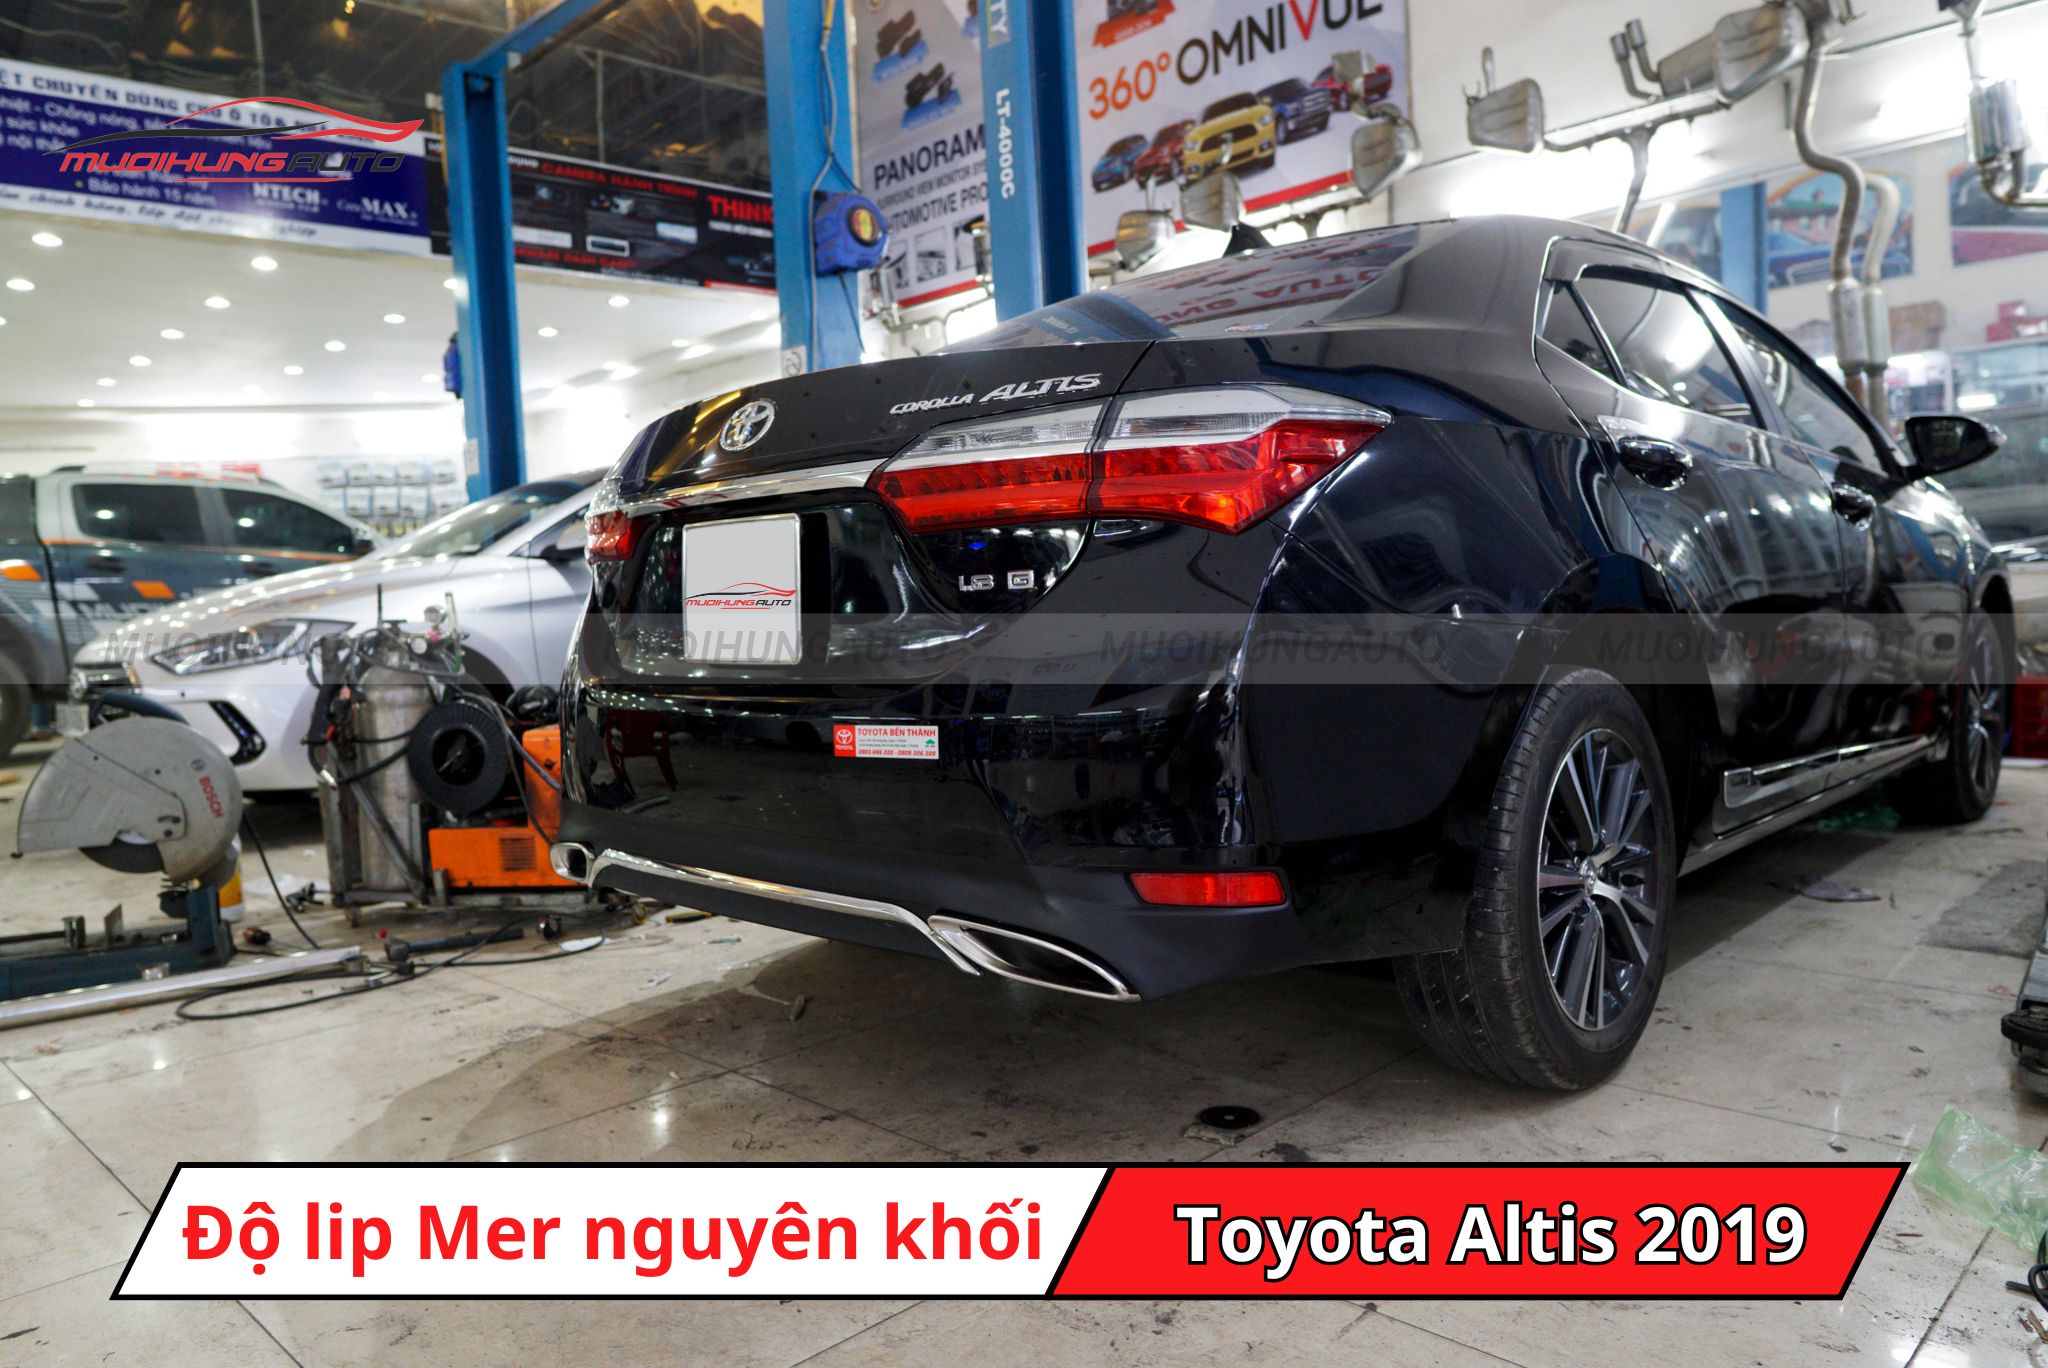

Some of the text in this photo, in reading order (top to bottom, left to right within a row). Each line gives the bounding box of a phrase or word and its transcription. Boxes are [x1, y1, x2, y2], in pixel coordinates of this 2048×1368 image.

[996, 88, 1016, 199] LT-4000C
[889, 373, 1103, 415] COROLLA ALTIS
[857, 728, 888, 737] TOYOTA
[907, 727, 936, 737] THÀNH
[199, 775, 224, 819] BOSCH
